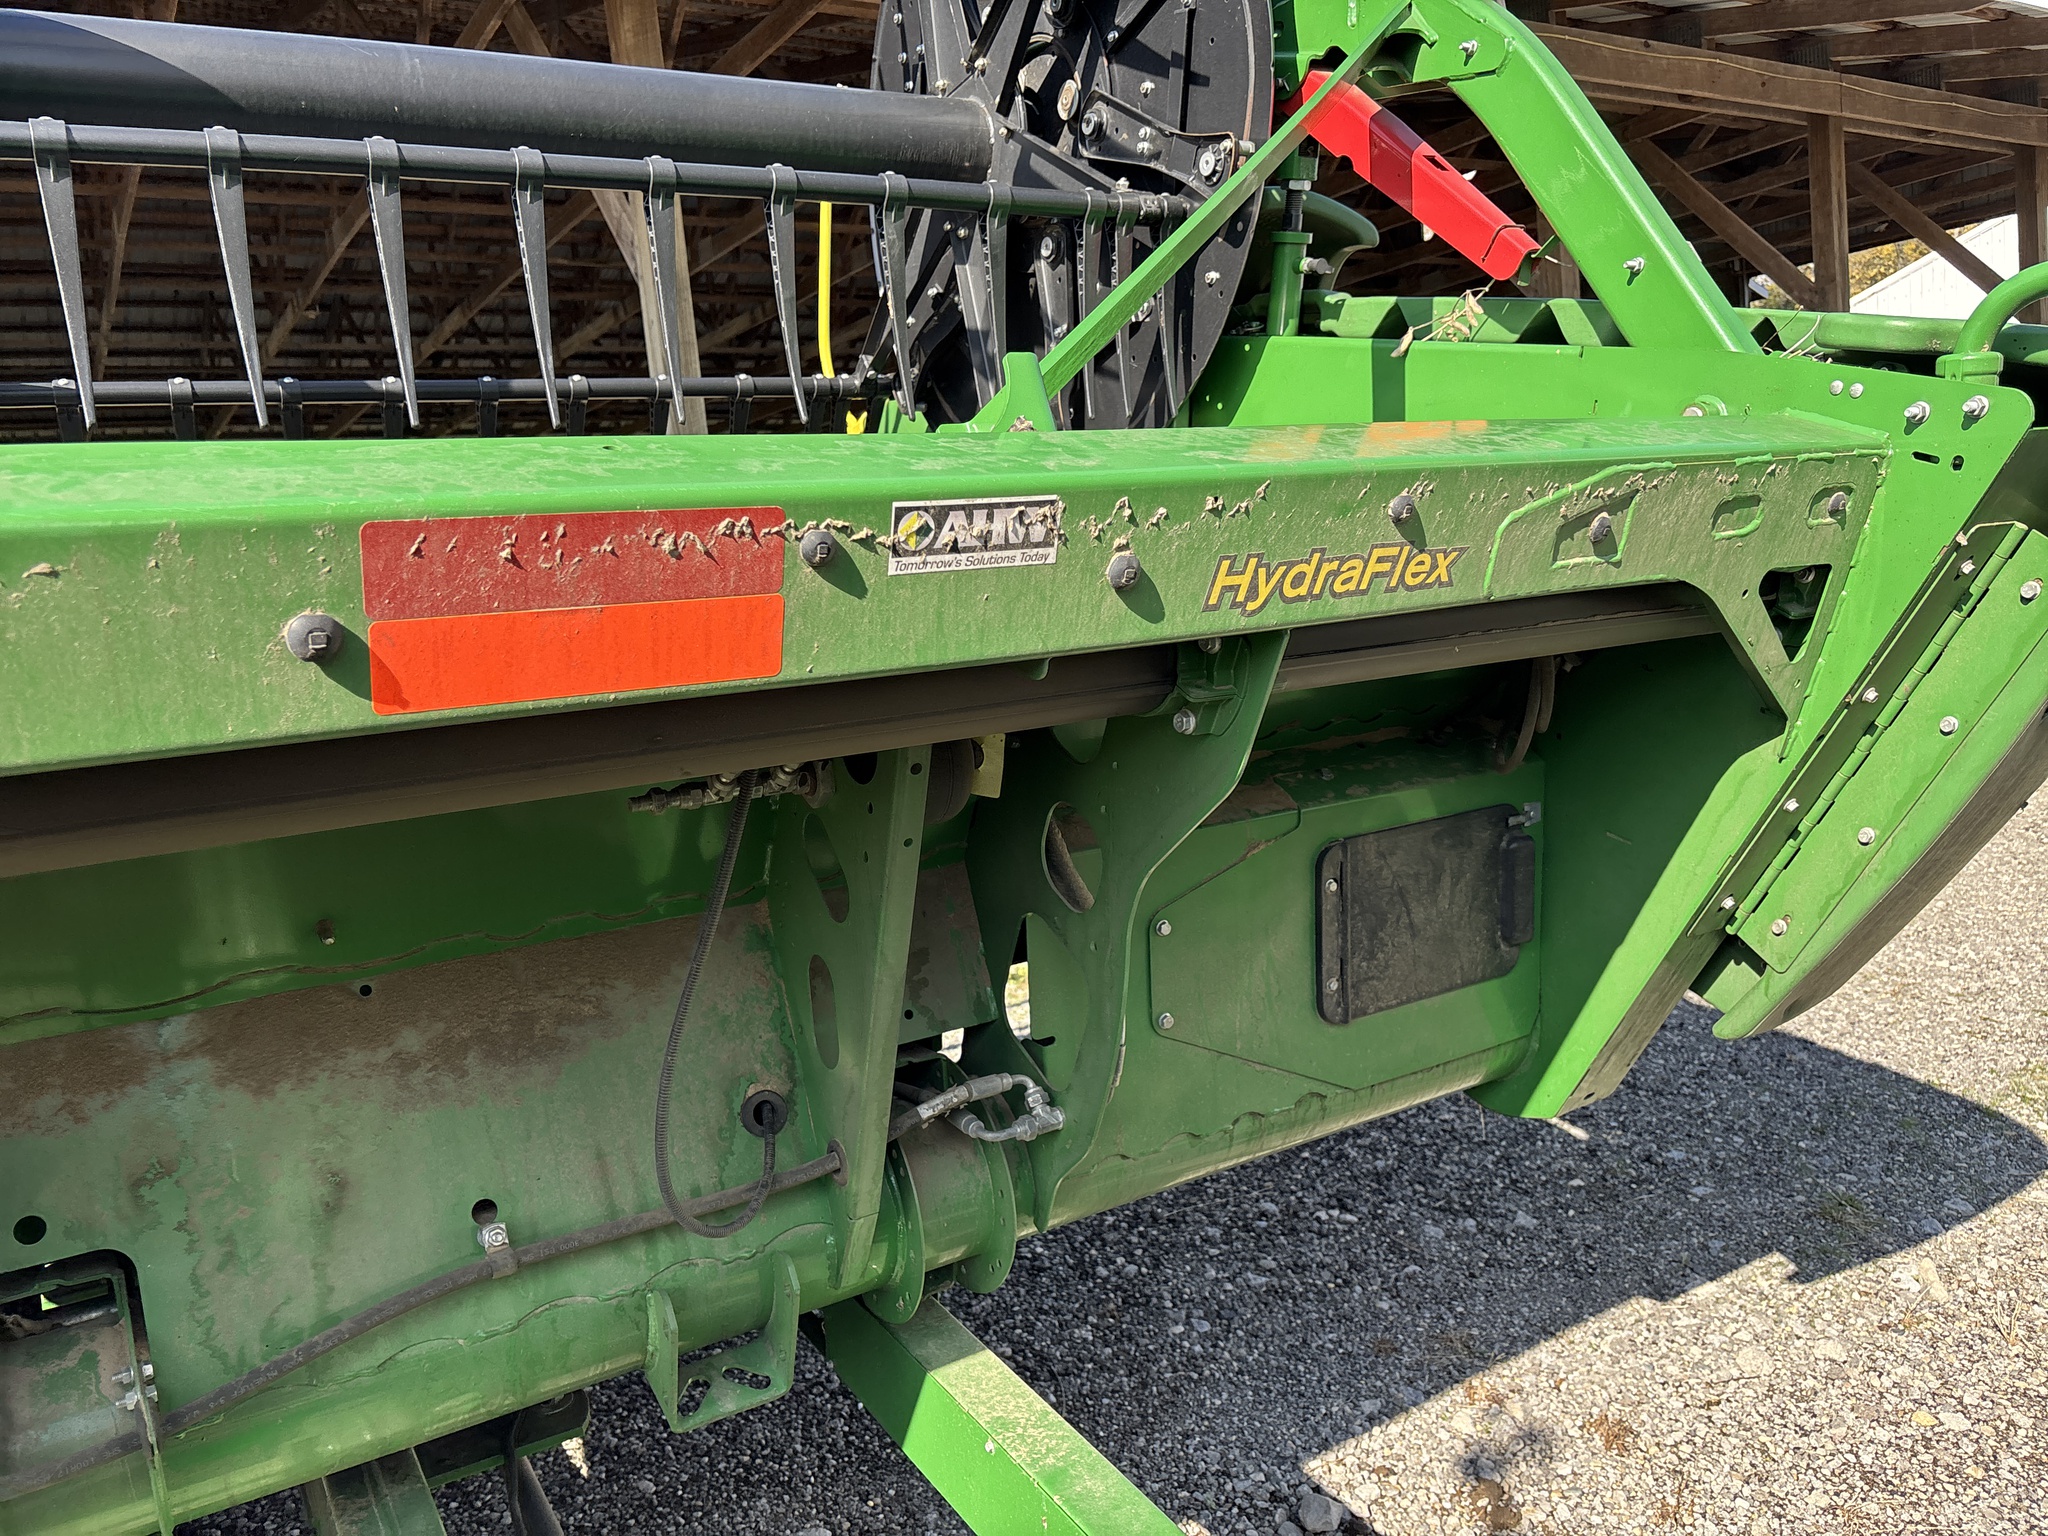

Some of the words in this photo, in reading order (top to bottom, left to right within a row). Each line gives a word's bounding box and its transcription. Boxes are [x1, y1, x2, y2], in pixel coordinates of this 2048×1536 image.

[894, 556, 962, 573] Tomorrow's
[965, 553, 1016, 568] Solutions
[1021, 551, 1051, 564] Today
[1204, 541, 1468, 616] HydraFlex
